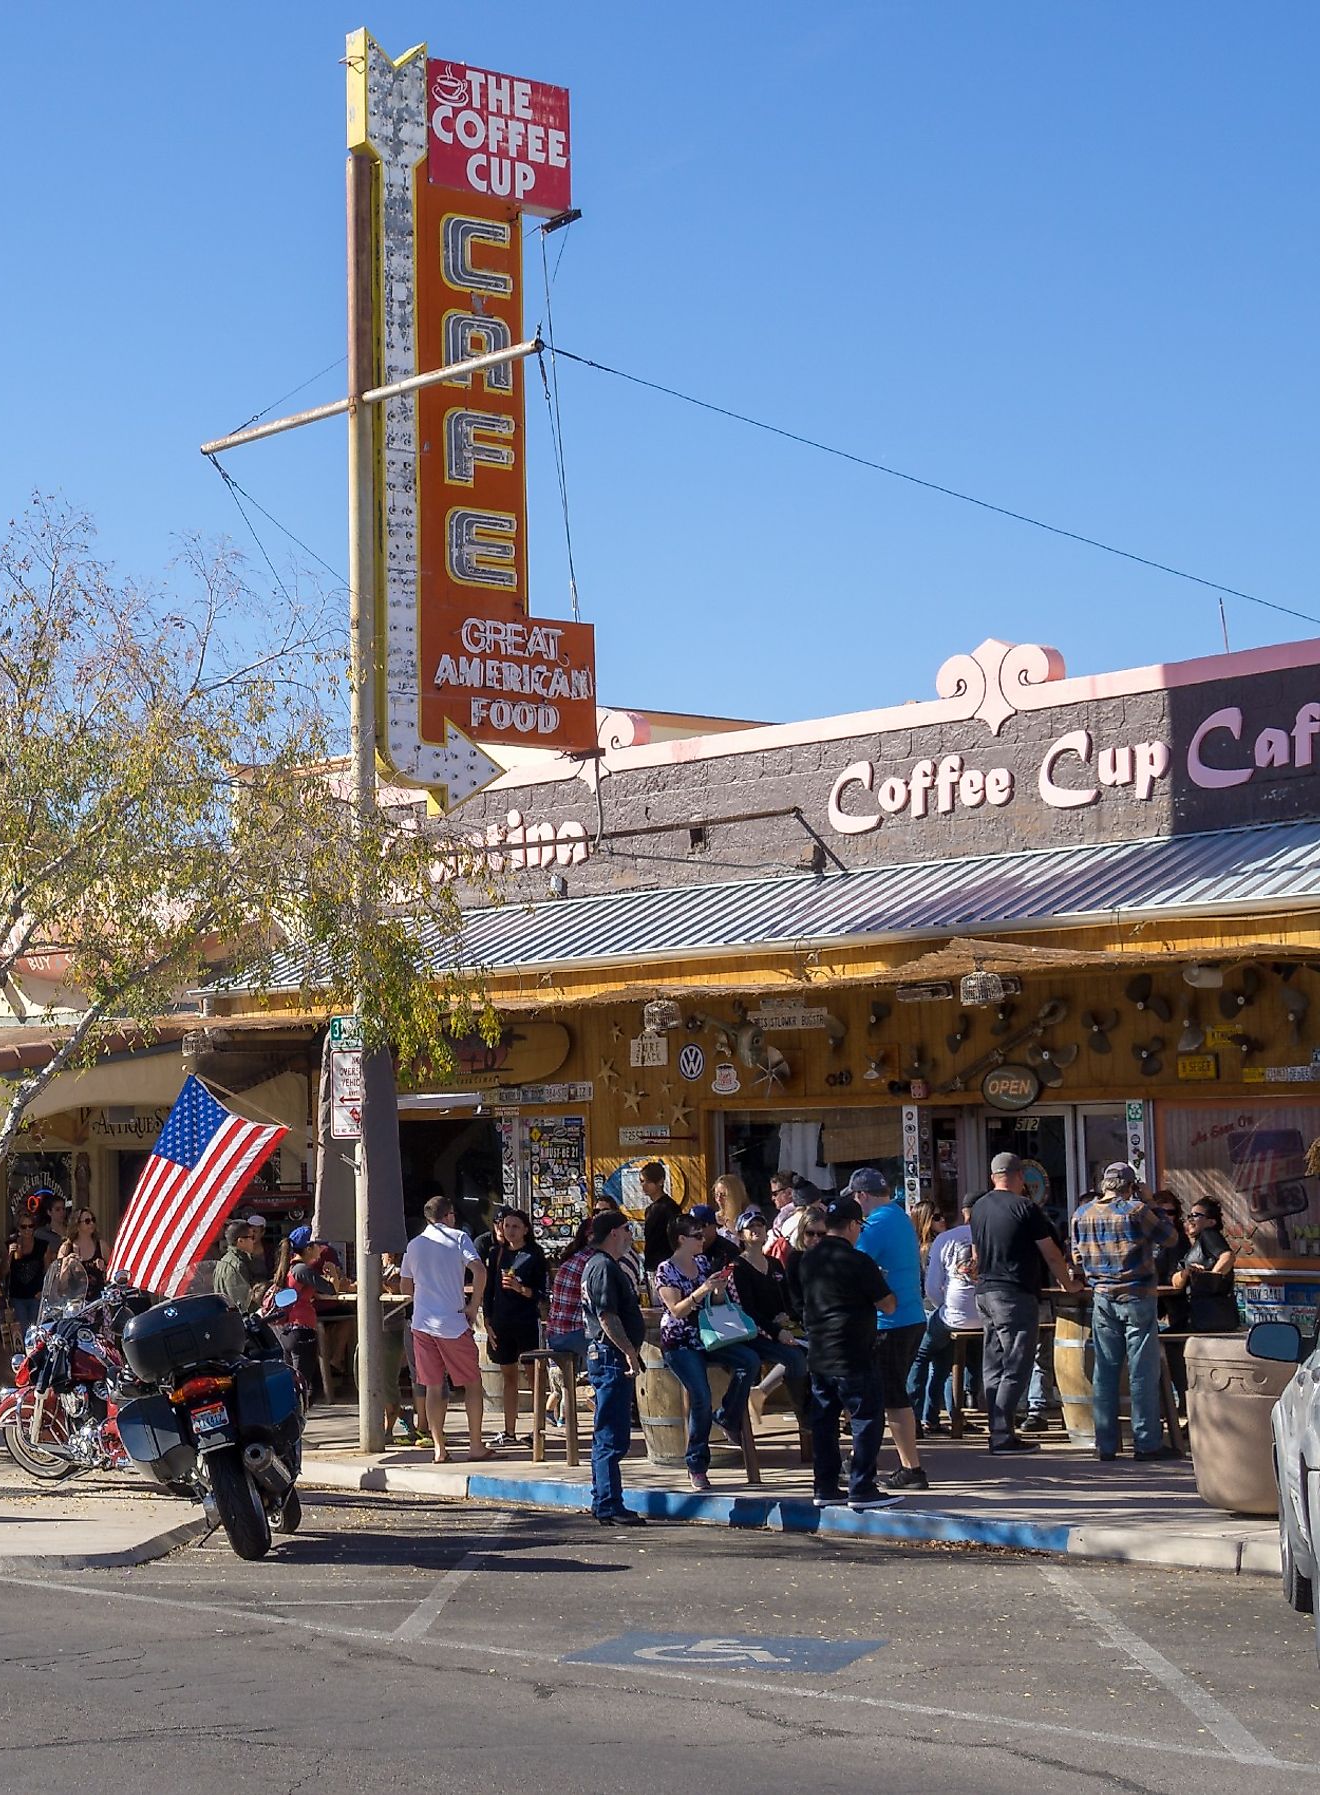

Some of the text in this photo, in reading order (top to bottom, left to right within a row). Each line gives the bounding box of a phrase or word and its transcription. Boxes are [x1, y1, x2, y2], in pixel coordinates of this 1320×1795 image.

[465, 70, 533, 118] THE
[431, 106, 568, 168] COFFEE
[466, 153, 537, 200] CUP
[440, 212, 518, 592] CAFE
[461, 616, 564, 660] GREAT
[434, 653, 594, 701] AMERICAN
[470, 696, 560, 733] FOOD
[827, 754, 1015, 836] Coffee
[1037, 730, 1171, 810] Cup
[26, 955, 51, 971] BUY
[332, 1020, 340, 1038] 3
[988, 1079, 1031, 1095] OPEN
[1016, 1119, 1038, 1130] 512
